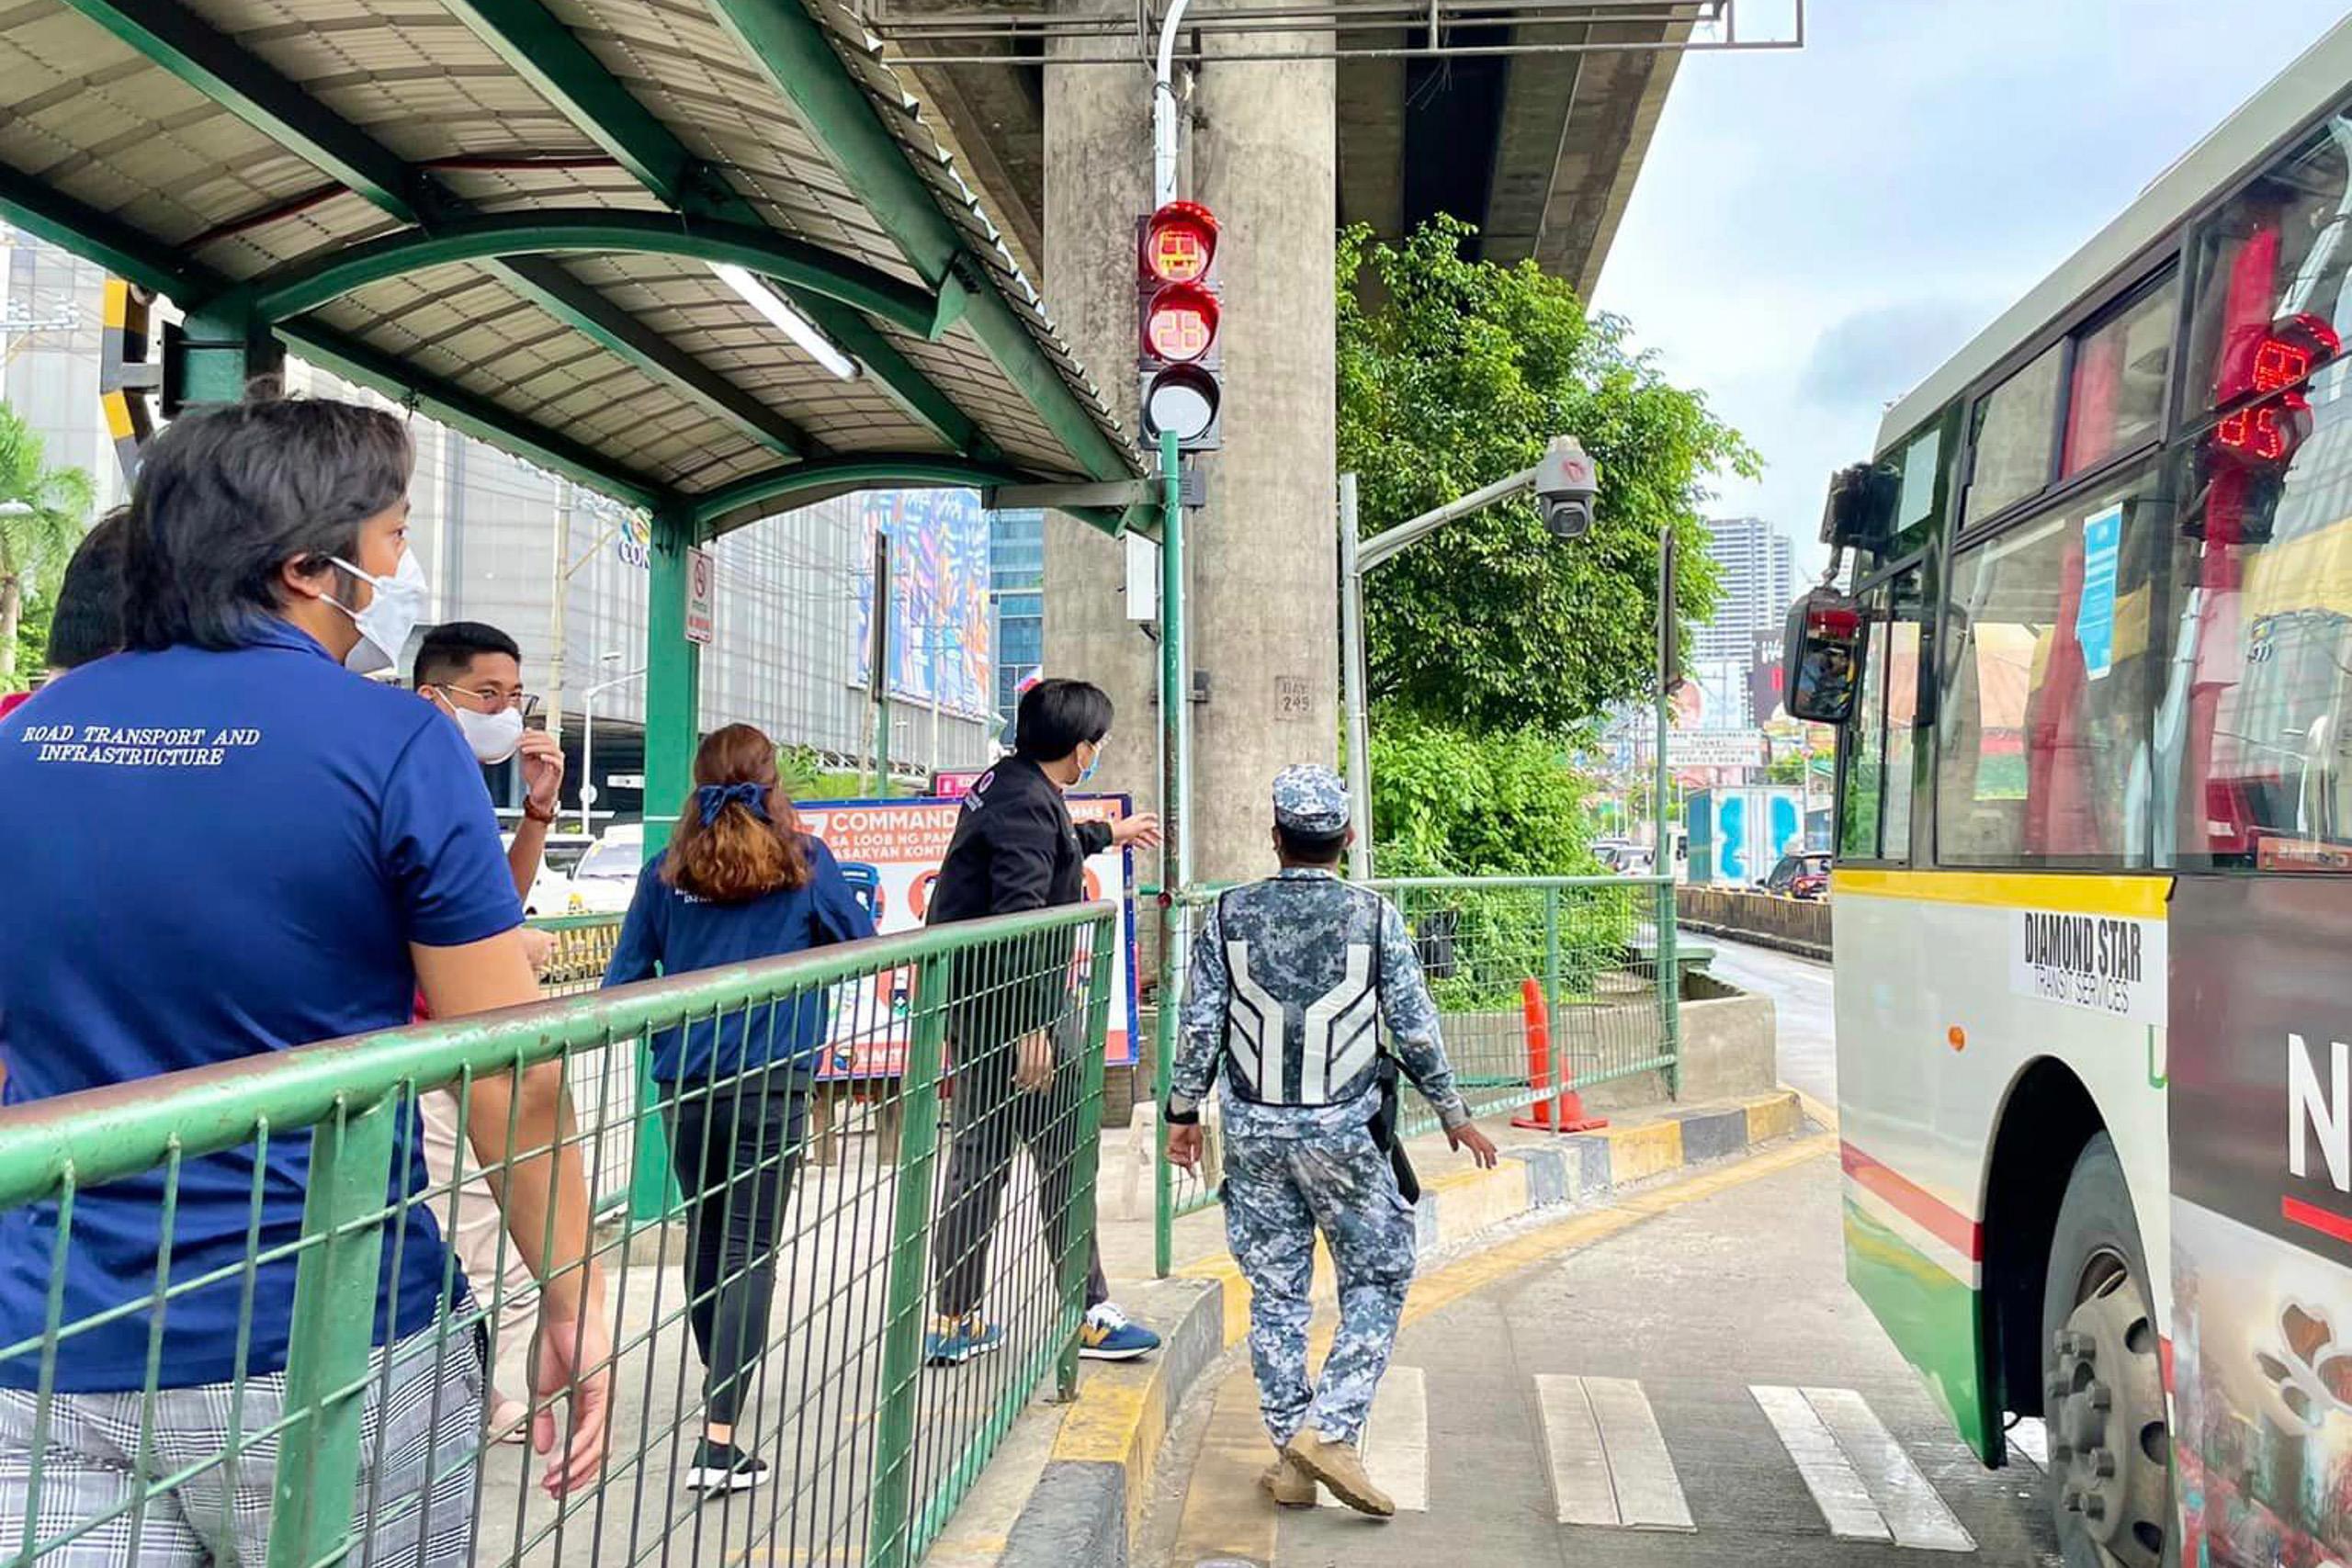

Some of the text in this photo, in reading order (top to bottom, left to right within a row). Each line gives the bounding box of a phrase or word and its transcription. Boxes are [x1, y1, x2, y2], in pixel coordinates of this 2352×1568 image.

[1157, 310, 1202, 348] 28
[21, 725, 261, 747] ROAD TRANSPORT AND
[38, 744, 225, 765] INFRASTRUCTURE
[854, 834, 893, 846] LOOB
[2024, 911, 2142, 982] DIAMOND STAR
